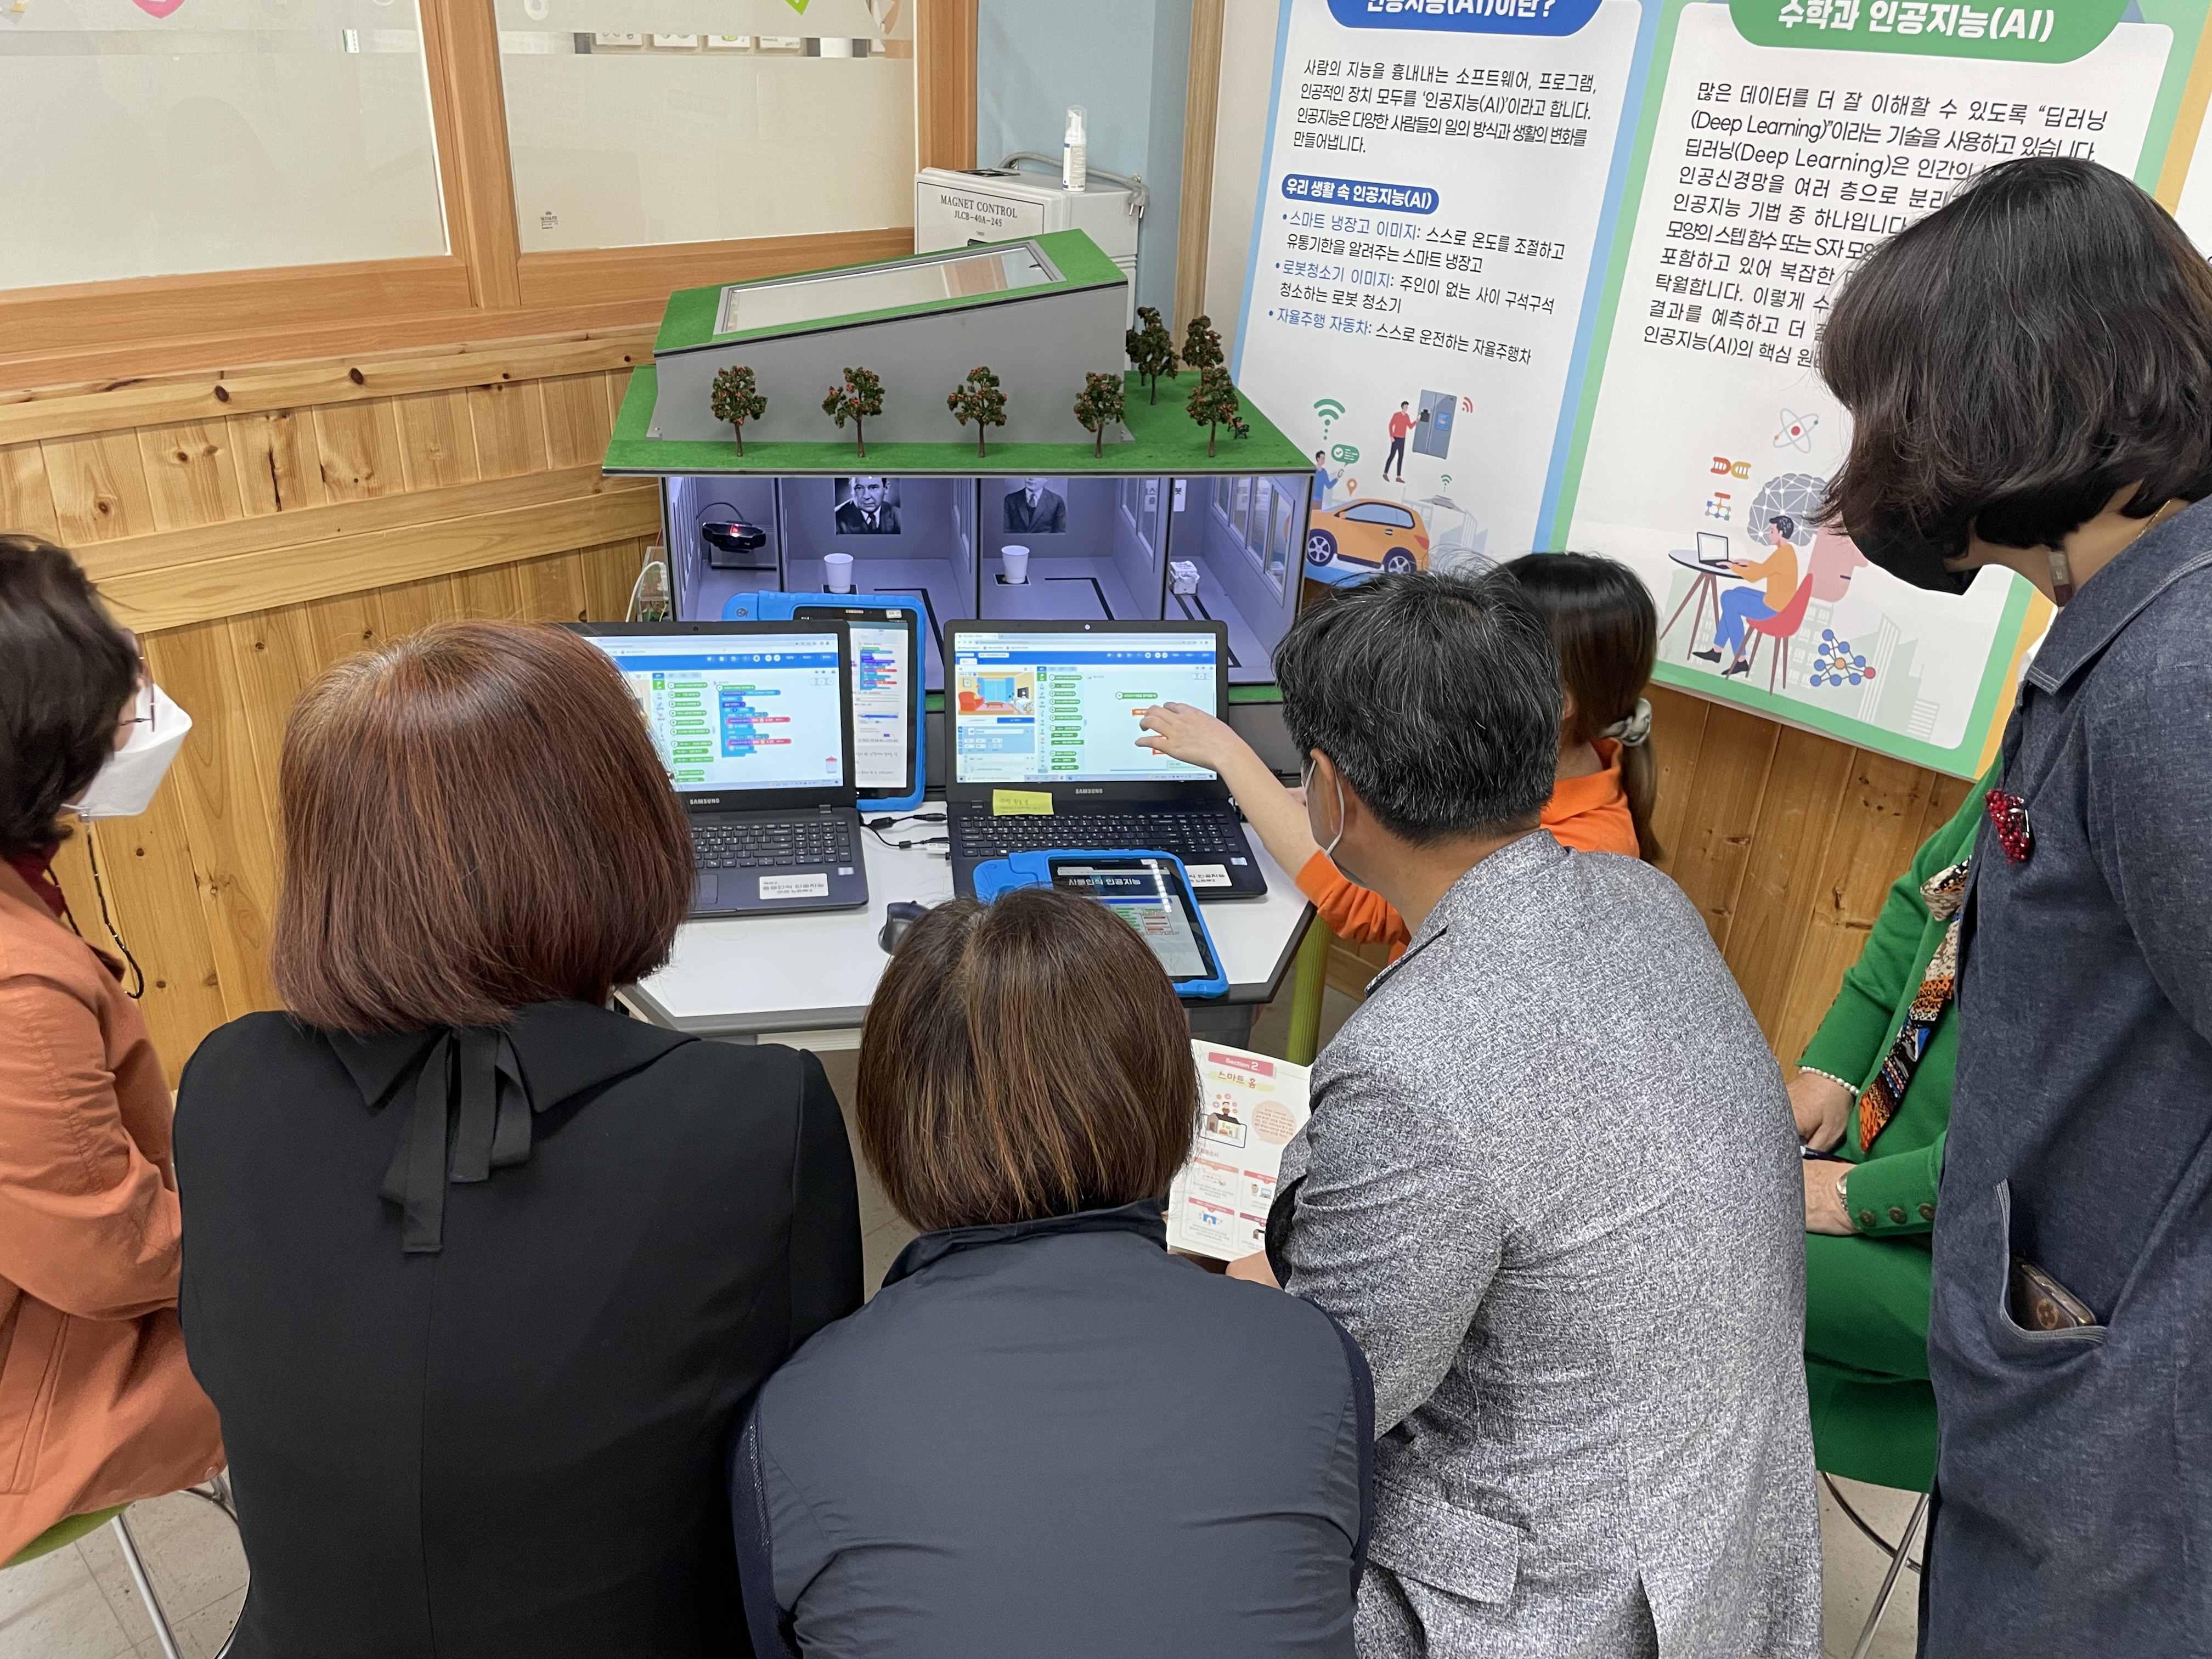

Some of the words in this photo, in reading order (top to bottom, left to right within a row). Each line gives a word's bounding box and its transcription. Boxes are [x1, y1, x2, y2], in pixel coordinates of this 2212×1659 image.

[1779, 0, 1860, 30] 수학과
[1869, 1, 2053, 42] 인공지능(AI)
[1304, 59, 1341, 77] 사람의
[1346, 61, 1385, 80] 지능을
[1391, 63, 1449, 84] 흉내내는
[1456, 69, 1531, 91] 소프트웨어,
[1538, 72, 1596, 94] 프로그램,
[1301, 83, 1344, 102] 인공적인
[1348, 86, 1372, 104] 장치
[1376, 88, 1417, 106] 모두를
[1549, 100, 1591, 120] 합니다.
[1697, 82, 1732, 104] 많은
[1740, 85, 1809, 109] 데이터를
[1817, 89, 1835, 109] 더
[1844, 91, 1863, 112] 잘
[1871, 93, 1931, 117] 이해할
[1939, 99, 1958, 120] 수
[1968, 100, 2028, 126] 있도록
[1293, 132, 1366, 154] 만들어냅니다.
[1297, 107, 1350, 126] 인공지능은
[1352, 111, 1389, 130] 다양한
[1390, 114, 1441, 134] 사람들의
[1444, 119, 1470, 136] 일의
[1474, 121, 1510, 140] 방식과
[1513, 125, 1548, 143] 생활의
[1550, 128, 1587, 147] 변화를
[1691, 110, 1742, 135] (Deep
[1886, 125, 1940, 150] 기술을
[1944, 128, 2017, 156] 사용하고
[1685, 138, 1788, 166] 딥러닝(Deep
[1795, 148, 1910, 178] Learning)은
[1917, 159, 1974, 182] 인간의
[1286, 178, 1308, 196] 우리
[1311, 180, 1335, 199] 생활
[1338, 183, 1350, 200] 속
[1353, 185, 1432, 211] 인공지능(AI)
[1679, 166, 1785, 194] 인공신경망을
[1795, 177, 1830, 199] 여러
[1840, 181, 1898, 205] 층으로
[941, 195, 974, 210] MAGNET
[977, 202, 1017, 218] CONTROL
[1673, 194, 1741, 217] 인공지능
[1748, 201, 1781, 222] 기법
[1788, 205, 1805, 224] 중
[1286, 233, 1345, 256] 유통기한을
[1349, 241, 1400, 263] 알려주는
[1402, 249, 1442, 268] 스마트
[1446, 253, 1482, 274] 냉장고
[1290, 212, 1325, 229] 스마트
[1331, 215, 1369, 234] 냉장고
[1376, 219, 1421, 241] 이미지:
[1426, 227, 1466, 246] 스스로
[1472, 232, 1510, 252] 온도를
[1514, 237, 1565, 260] 조절하고
[1666, 221, 1714, 242] 모양의
[1714, 225, 1746, 246] 스텝
[1748, 230, 1777, 250] 함수
[1779, 234, 1812, 255] 또는
[1814, 238, 1844, 258] S자
[1660, 248, 1730, 272] 포함하고
[1739, 257, 1772, 278] 있어
[1780, 262, 1835, 285] 복잡한
[1280, 281, 1328, 303] 청소하는
[1331, 290, 1357, 307] 로봇
[1362, 294, 1402, 314] 청소기
[1282, 259, 1345, 283] 로봇청소기
[1351, 268, 1394, 289] 이미지:
[1400, 275, 1440, 296] 주인이
[1446, 281, 1471, 300] 없는
[1476, 286, 1500, 306] 사이
[1504, 291, 1555, 315] 구석구석
[1655, 274, 1743, 302] 탁월합니다.
[1753, 287, 1805, 311] 이렇게
[1277, 308, 1325, 330] 자율주행
[1329, 315, 1372, 336] 자동차:
[1375, 323, 1415, 343] 스스로
[1419, 330, 1470, 353] 운전하는
[1472, 338, 1531, 366] 자율주행차
[1649, 300, 1702, 323] 결과를
[1712, 308, 1780, 334] 예측하고
[1788, 319, 1805, 338] 더
[1644, 326, 1754, 358] 인공지능(AI)의
[1759, 343, 1793, 365] 핵심
[1217, 1071, 1244, 1084] 스마트
[1248, 1078, 1256, 1088] 홈
[1225, 1058, 1250, 1069] Section
